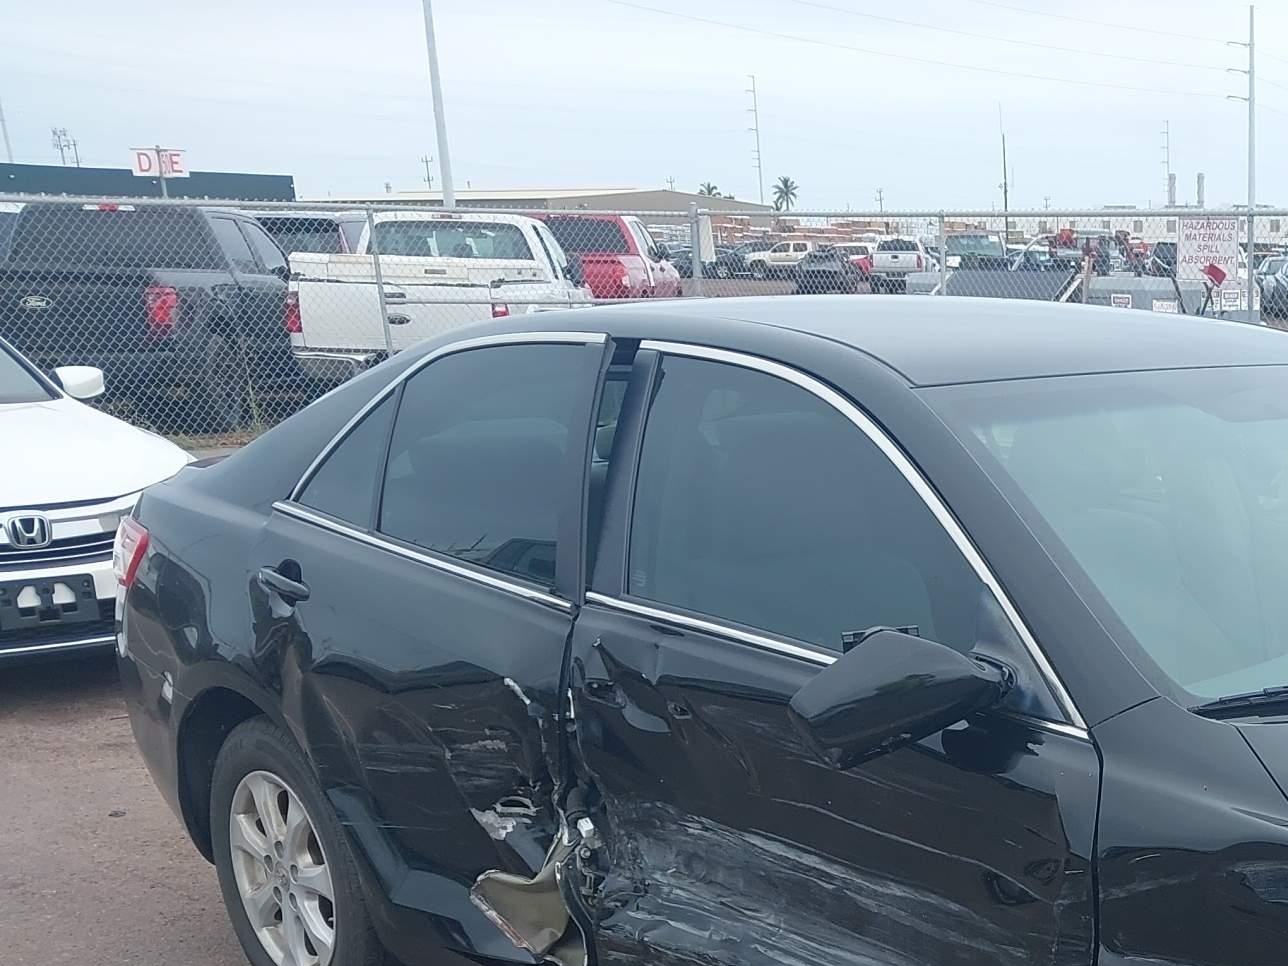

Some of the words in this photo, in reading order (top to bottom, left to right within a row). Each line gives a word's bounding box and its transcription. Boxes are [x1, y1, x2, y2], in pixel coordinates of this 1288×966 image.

[1182, 221, 1236, 231] HAZARDOUS
[1184, 232, 1233, 242] MATERIALS
[1196, 244, 1220, 253] SPILL
[1181, 255, 1235, 265] ABSORBENT
